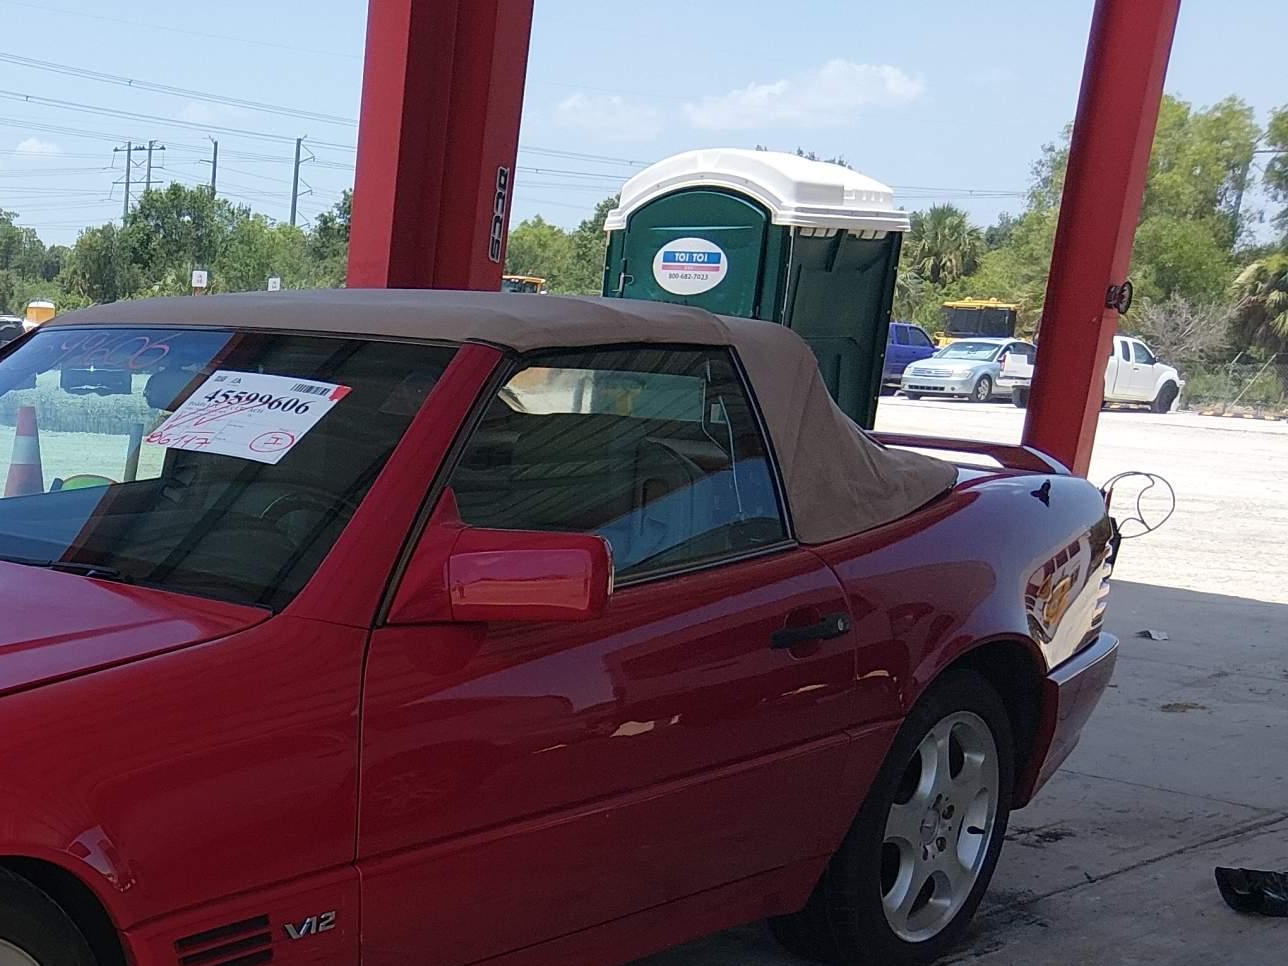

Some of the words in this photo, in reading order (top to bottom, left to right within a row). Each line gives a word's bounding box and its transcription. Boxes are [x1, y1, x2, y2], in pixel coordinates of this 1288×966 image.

[675, 253, 689, 262] TOI
[692, 253, 708, 262] TOI
[204, 388, 316, 415] 45599606
[284, 910, 337, 940] V12
